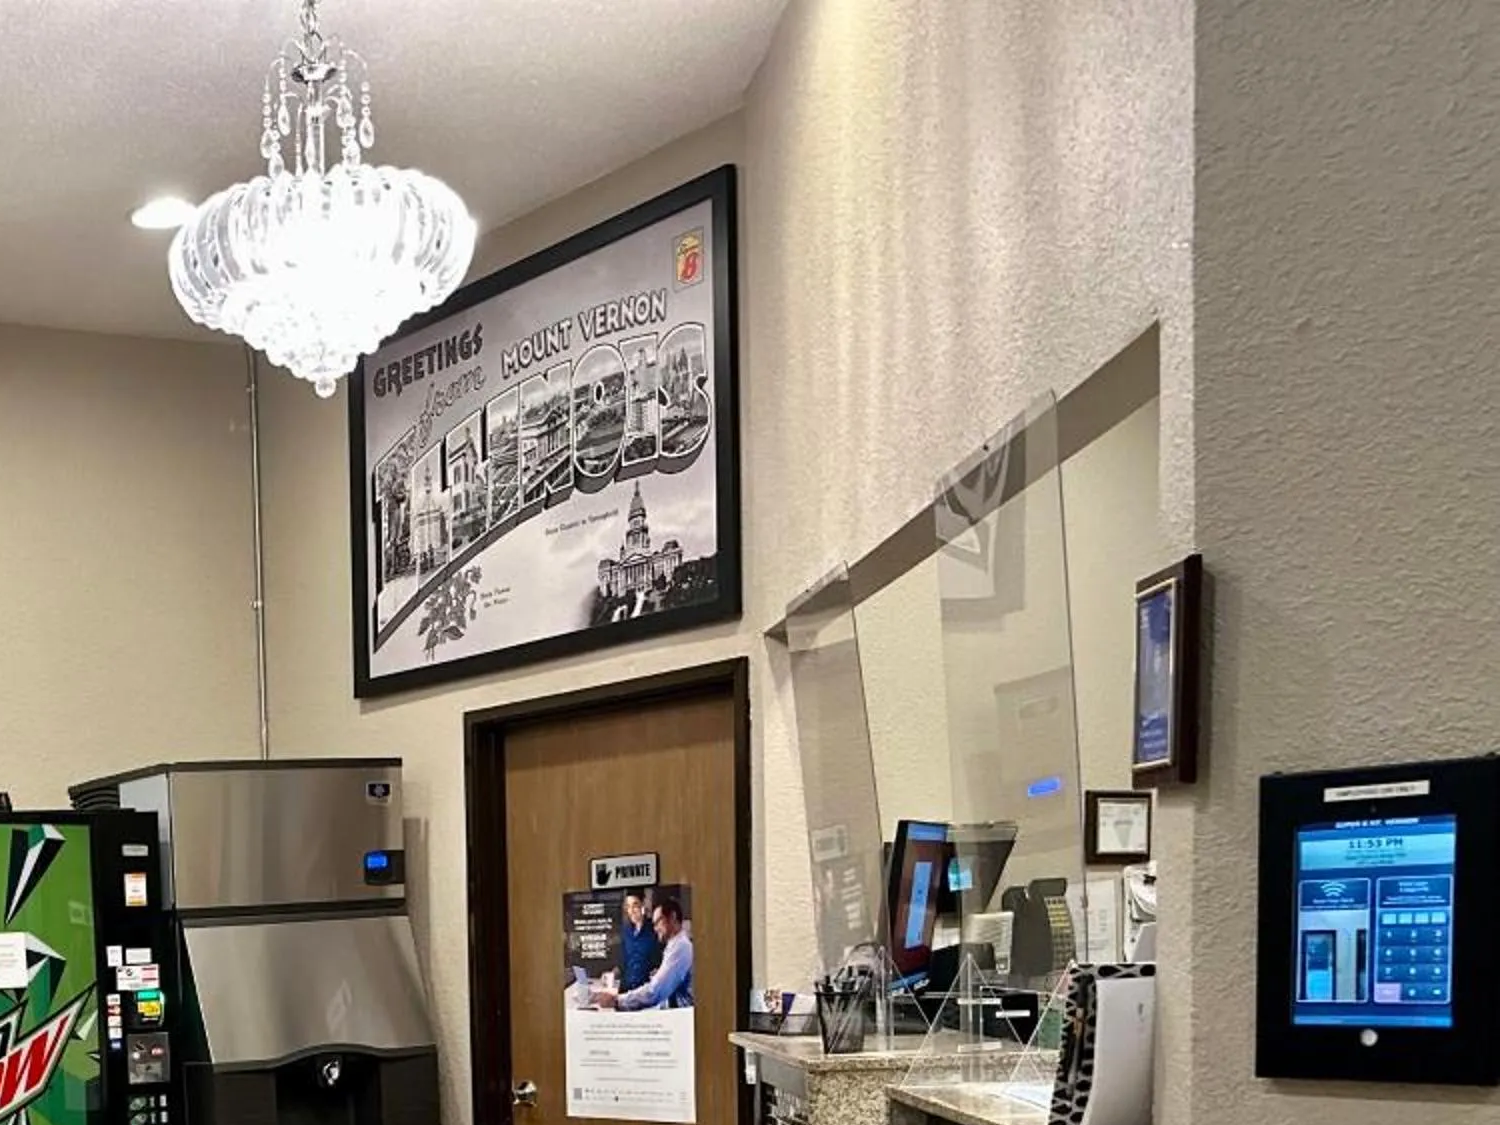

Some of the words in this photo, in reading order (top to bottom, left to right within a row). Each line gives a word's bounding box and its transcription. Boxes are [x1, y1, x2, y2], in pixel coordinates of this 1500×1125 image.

[373, 322, 484, 398] GREETINGS
[501, 317, 573, 380] MOUNT
[578, 287, 668, 342] VERNON
[374, 321, 713, 648] ILLINOIS
[615, 863, 651, 880] PRIVATE
[1385, 837, 1404, 847] PM
